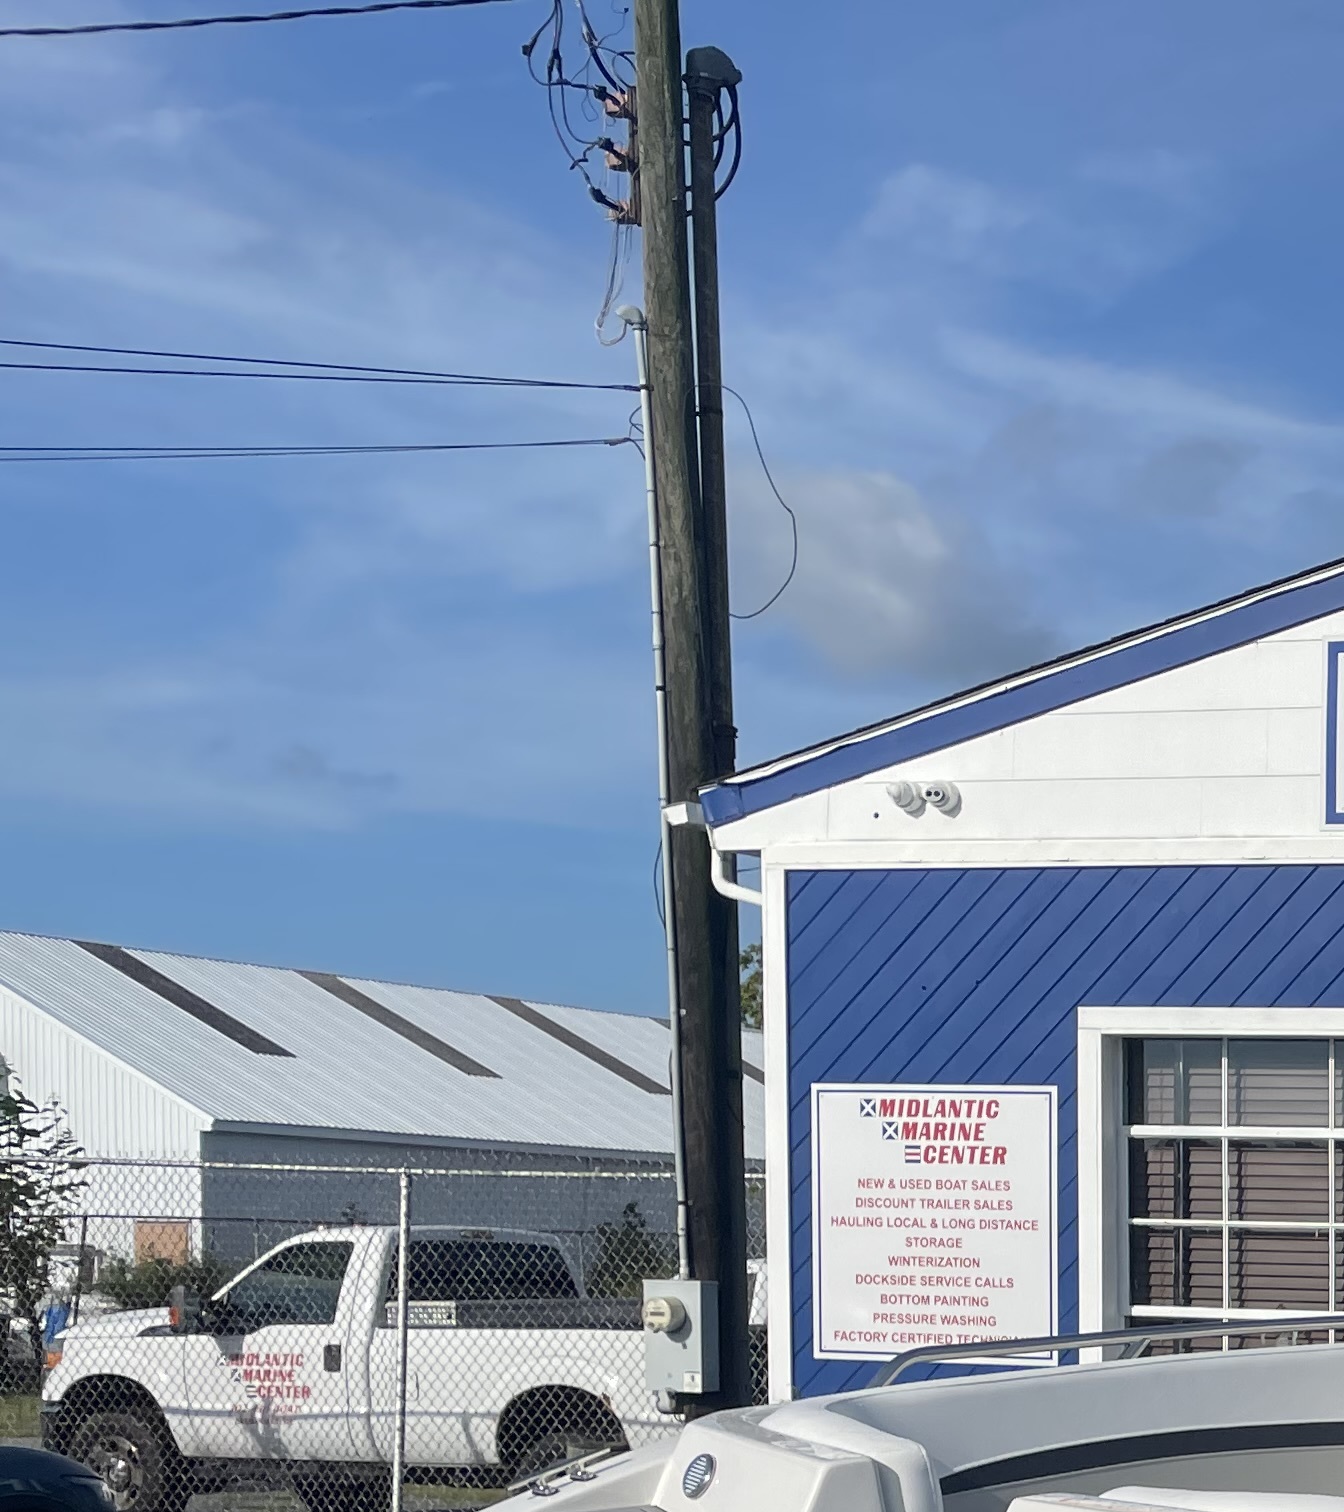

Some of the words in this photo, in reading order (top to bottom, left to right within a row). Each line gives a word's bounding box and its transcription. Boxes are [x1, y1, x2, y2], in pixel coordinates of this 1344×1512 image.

[879, 1099, 1000, 1119] MIDLANTIC
[901, 1122, 986, 1141] MARINE
[923, 1145, 1007, 1165] CENTER
[857, 1178, 885, 1190] NEW
[888, 1179, 896, 1190] &
[900, 1179, 932, 1190] USED
[935, 1179, 968, 1191] BOAT
[971, 1180, 1011, 1191] SALES
[855, 1197, 916, 1209] DISCOUNT
[920, 1198, 970, 1210] TRAILER
[974, 1199, 1013, 1211] SALES
[831, 1216, 883, 1228] HAULING
[887, 1217, 927, 1228] LOCAL
[930, 1218, 938, 1228] &
[942, 1219, 975, 1230] LONG
[979, 1219, 1039, 1231] DISTANCE
[905, 1237, 963, 1249] STORAGE
[888, 1255, 981, 1268] WINTERIZATION
[855, 1274, 917, 1286] DOCKSIDE
[920, 1275, 971, 1287] SERVICE
[974, 1277, 1014, 1288] CALLS
[880, 1294, 931, 1306] BOTTOM
[934, 1295, 989, 1307] PAINTING
[873, 1313, 937, 1325] PRESSURE
[940, 1314, 997, 1327] WASHING
[834, 1331, 888, 1343] FACTORY
[891, 1332, 953, 1345] CERTIFIED
[243, 1369, 295, 1382] MARINE
[258, 1385, 311, 1399] CENTER
